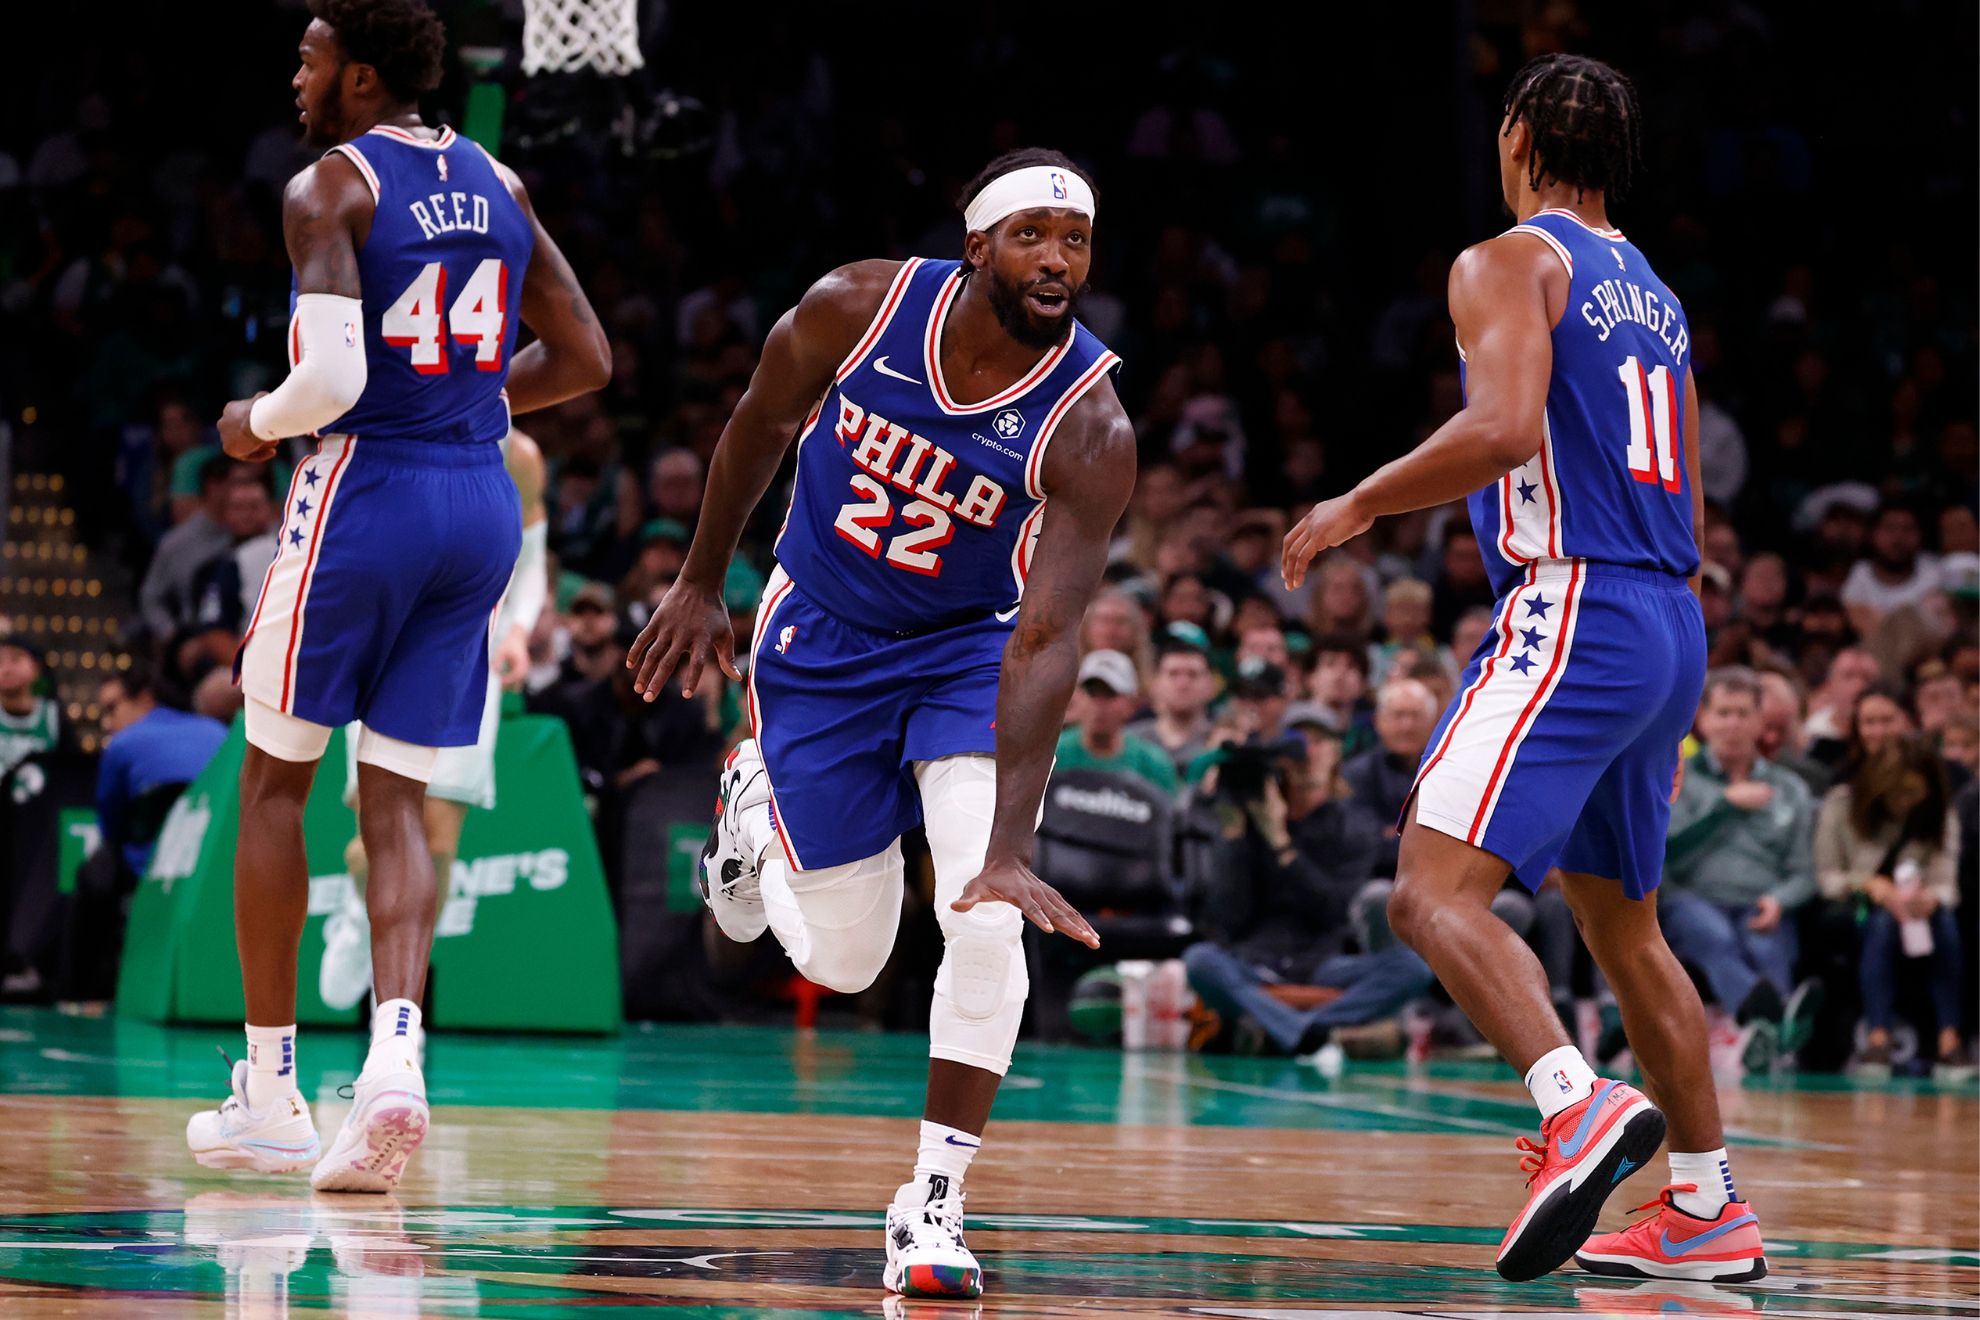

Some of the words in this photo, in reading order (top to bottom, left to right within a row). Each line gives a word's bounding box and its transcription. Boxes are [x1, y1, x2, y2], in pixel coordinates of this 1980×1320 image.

[409, 191, 489, 240] REED
[381, 258, 509, 375] 44
[1581, 279, 1689, 366] SPRINGER
[834, 392, 1008, 529] PHILA
[971, 432, 1024, 462] crypto.com
[1618, 355, 1681, 494] 11
[834, 473, 957, 578] 22
